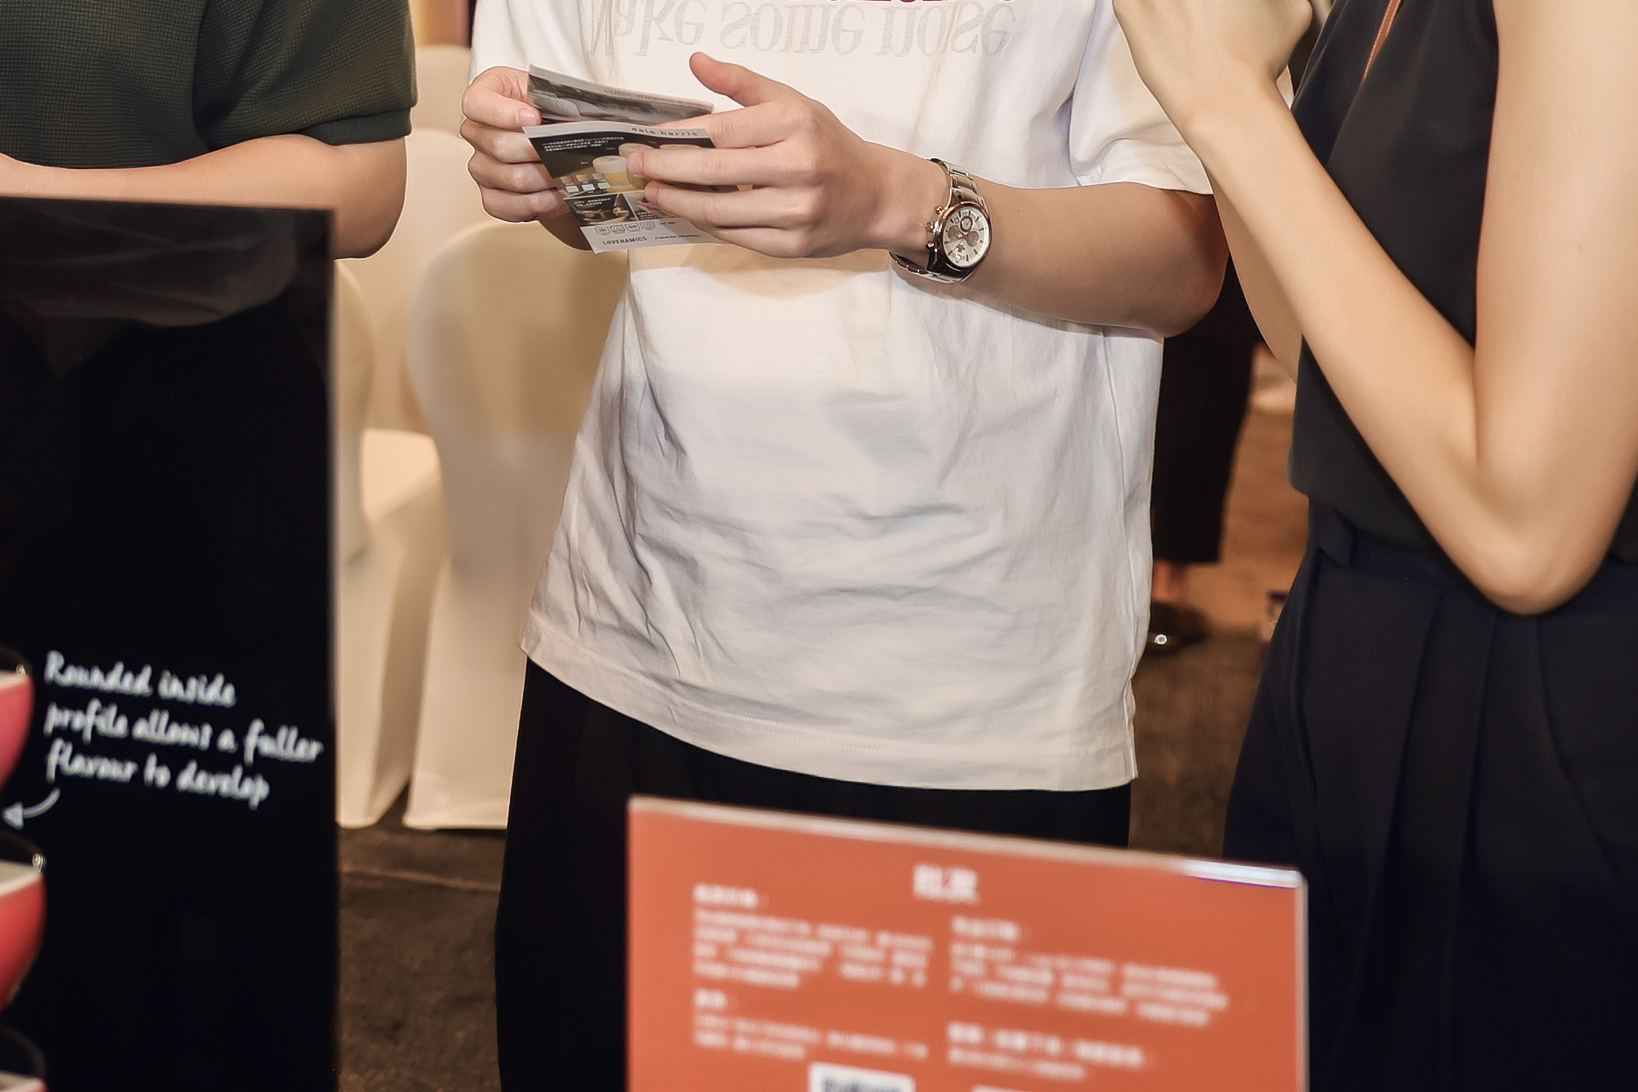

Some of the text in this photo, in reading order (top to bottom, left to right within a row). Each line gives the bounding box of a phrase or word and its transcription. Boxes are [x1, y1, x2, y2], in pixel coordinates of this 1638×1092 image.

[602, 236, 648, 246] LOVERAMICS
[44, 650, 236, 707] Rounded inside
[44, 698, 323, 765] profile allows a fuller
[46, 738, 270, 809] flavour to develop
